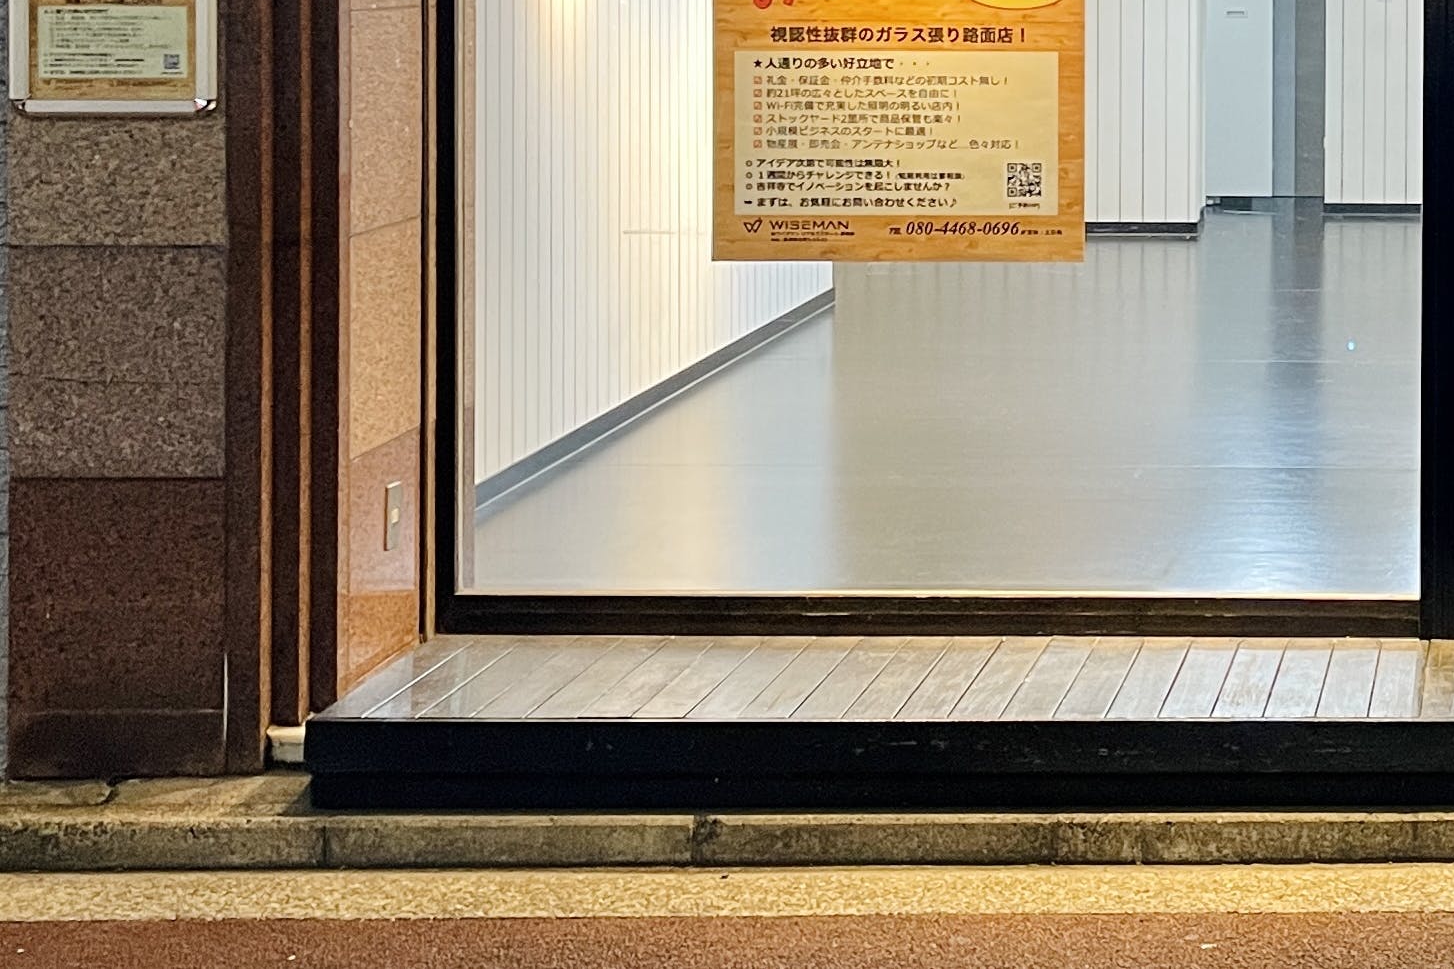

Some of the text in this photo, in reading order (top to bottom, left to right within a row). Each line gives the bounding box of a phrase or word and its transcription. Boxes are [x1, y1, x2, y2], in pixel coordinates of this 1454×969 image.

[770, 25, 1026, 44] 視認性抜群のガラス張り路面店！
[769, 220, 850, 230] WISEMAN
[905, 221, 1021, 236] 080-4468-0696
